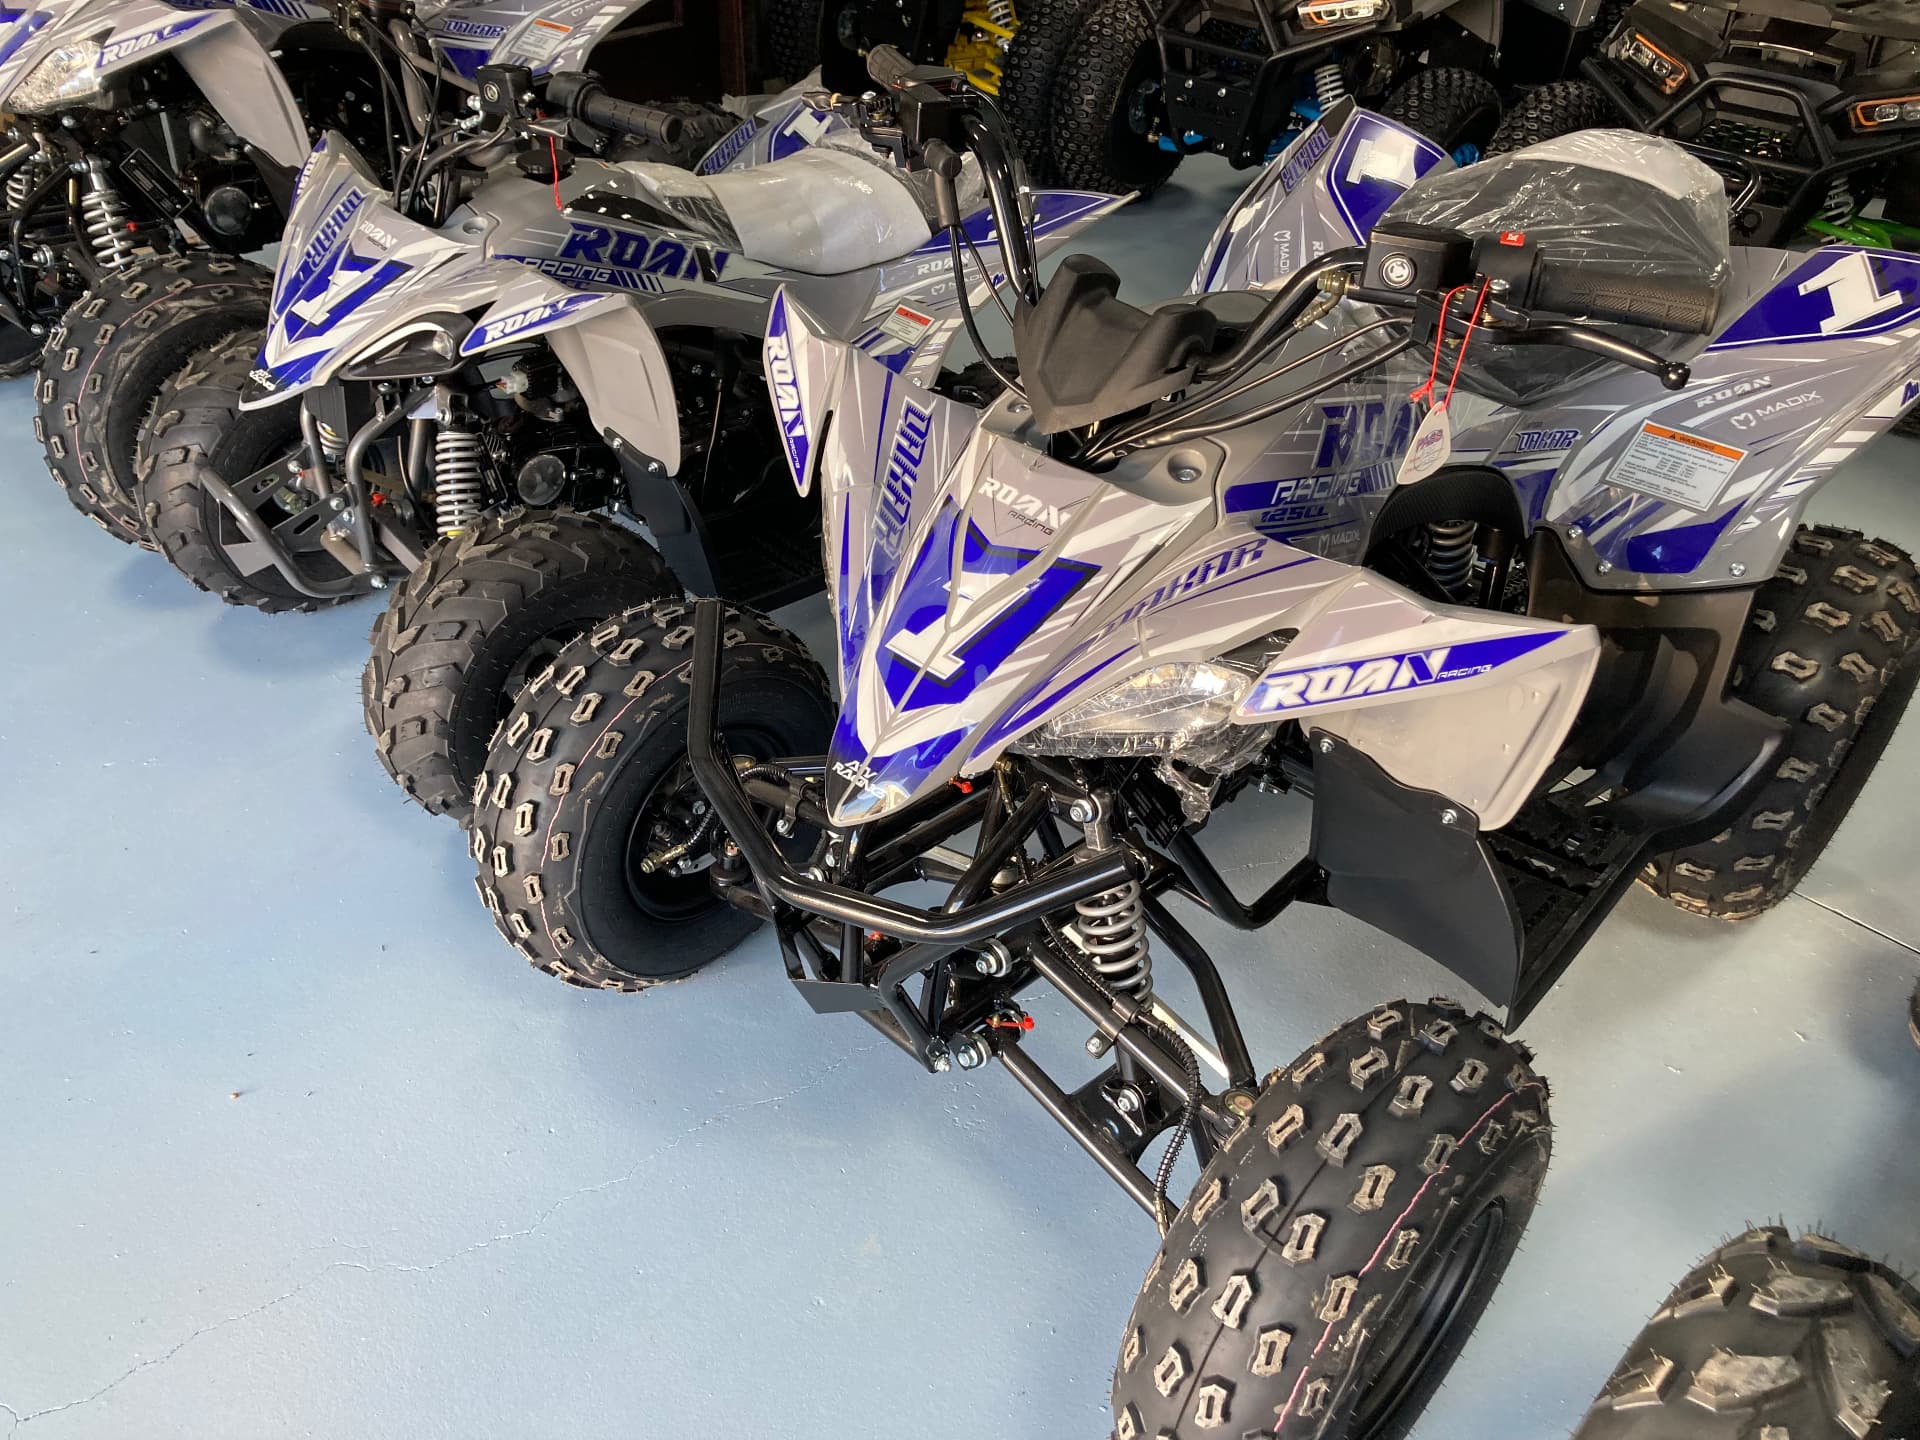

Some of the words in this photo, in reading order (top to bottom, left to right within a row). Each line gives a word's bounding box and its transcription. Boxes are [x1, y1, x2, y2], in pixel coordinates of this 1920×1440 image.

[102, 25, 174, 64] ROAN
[444, 18, 505, 39] DAKAR
[1280, 124, 1334, 193] DAKAR
[303, 185, 370, 271] DAKAR
[557, 222, 731, 284] ROAN
[289, 269, 375, 326] 1
[484, 299, 569, 345] ROAN
[1798, 250, 1904, 337] 1
[768, 330, 806, 438] ROAN
[1694, 375, 1772, 408] ROAN
[1755, 390, 1823, 417] MADIX
[1316, 402, 1424, 469] ROA
[1515, 429, 1581, 452] DAKAR
[871, 394, 938, 560] DAKAR
[977, 476, 1072, 529] ROAN
[1271, 471, 1363, 505] RACING
[1007, 509, 1056, 537] RACING
[1100, 537, 1268, 642] DAKAR
[884, 571, 1034, 681] 1
[1260, 647, 1451, 711] ROAN
[1436, 664, 1493, 681] RACING
